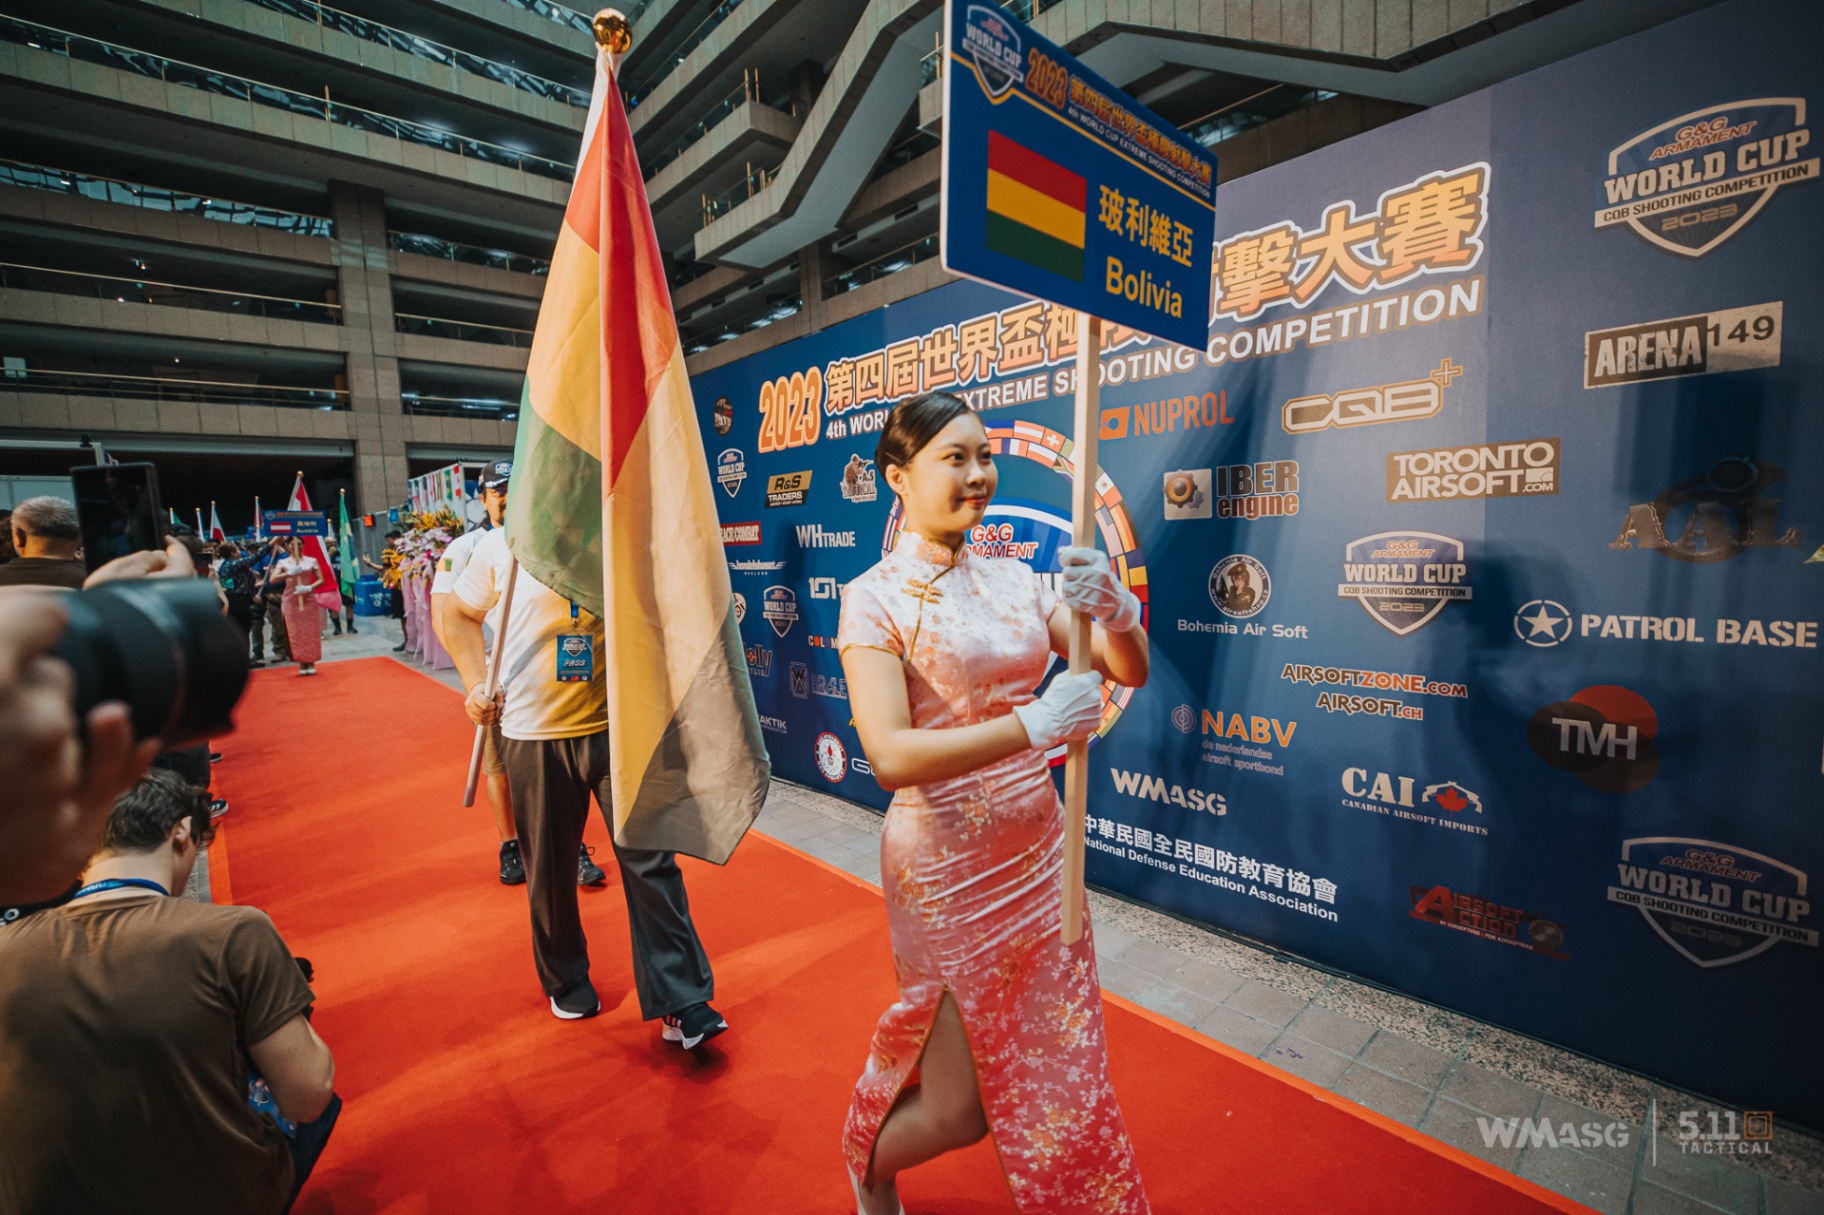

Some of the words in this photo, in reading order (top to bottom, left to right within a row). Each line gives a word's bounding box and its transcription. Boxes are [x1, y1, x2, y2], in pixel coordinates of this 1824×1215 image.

[966, 22, 1001, 57] WORLD
[1003, 46, 1022, 68] CUP
[1025, 47, 1068, 109] 2023
[1649, 121, 1757, 161] ARMAMENT
[1676, 116, 1729, 142] G&G
[1080, 110, 1105, 135] WORLD
[1105, 130, 1119, 142] CUP
[1119, 138, 1147, 162] EXTREME
[1148, 155, 1177, 179] SHOOTING
[1177, 174, 1210, 199] COMPETITION
[1604, 151, 1726, 204] WORLD
[1737, 128, 1810, 173] CUP
[1603, 209, 1630, 223] CQB
[1632, 190, 1702, 216] SHOOTING
[1705, 163, 1809, 199] COMPETITION
[1098, 184, 1194, 268] 玻利維亞
[1661, 202, 1738, 231] 2023
[827, 168, 1484, 414] 第四屆世界盃極擊大賽
[1106, 256, 1183, 319] Bolivia
[826, 420, 847, 439] 4th
[849, 410, 890, 436] WOR
[956, 374, 1048, 411] XTREME
[1206, 279, 1480, 364] COMPETITION
[1594, 325, 1703, 378] ARENA
[1707, 315, 1775, 347] 149
[758, 366, 823, 453] 2023
[1134, 391, 1235, 437] NUPROL
[718, 463, 734, 475] WORLD
[735, 461, 745, 472] CUP
[1393, 441, 1554, 477] TORONTO
[774, 474, 802, 490] R&S
[1216, 459, 1299, 498] IBER
[768, 491, 802, 502] TRADERS
[1216, 493, 1299, 520] engine
[966, 543, 1038, 558] MAMENT
[971, 524, 1013, 543] G&G
[1387, 540, 1418, 550] G&G
[1371, 549, 1435, 558] ARMAMENT
[1344, 563, 1417, 583] WORLD
[1423, 563, 1466, 584] CUP
[764, 600, 784, 612] WORLD
[785, 602, 796, 613] CUP
[1344, 586, 1360, 595] CQB
[1361, 586, 1403, 596] SHOOTING
[1405, 587, 1466, 597] COMPETITION
[1379, 602, 1425, 613] 2023
[1177, 619, 1237, 635] Bohemia
[1243, 622, 1266, 636] Air
[1272, 624, 1308, 639] Soft
[1581, 614, 1705, 643] PATROL
[1716, 619, 1818, 648] BASE
[563, 659, 586, 667] PASS
[1281, 663, 1468, 698] AIRSOFTZONE.COM
[759, 715, 787, 730] AKTIK
[1316, 692, 1423, 720] AIRSOFT.CH
[1201, 709, 1297, 748] NABV
[1551, 717, 1638, 760] TMH
[1202, 739, 1214, 749] de
[1215, 743, 1273, 760] nederlandse
[1202, 753, 1232, 766] airsoft
[1234, 759, 1284, 776] sportbond
[1110, 768, 1227, 816] WMASG
[1341, 767, 1415, 808] CAI
[1342, 798, 1390, 816] CANADIAN
[1392, 809, 1437, 826] AIRSOFT
[1438, 819, 1489, 836] IMPORTS
[1085, 814, 1338, 904] 中華民國全民國防教育協會
[1660, 856, 1762, 883] ARMAMENT
[1685, 849, 1735, 867] G&G
[1084, 836, 1126, 858] National
[1128, 850, 1176, 873] Defense
[1179, 864, 1246, 894] Education
[1248, 885, 1339, 923] Association
[1617, 864, 1732, 908] WORLD
[1742, 889, 1811, 923] CUP
[1447, 922, 1480, 937] AIRSOFTERS
[1497, 936, 1534, 950] AIRSOFTERS
[1643, 896, 1708, 919] SHOOTING
[1711, 911, 1809, 942] COMPETITION
[1670, 921, 1742, 947] 2023
